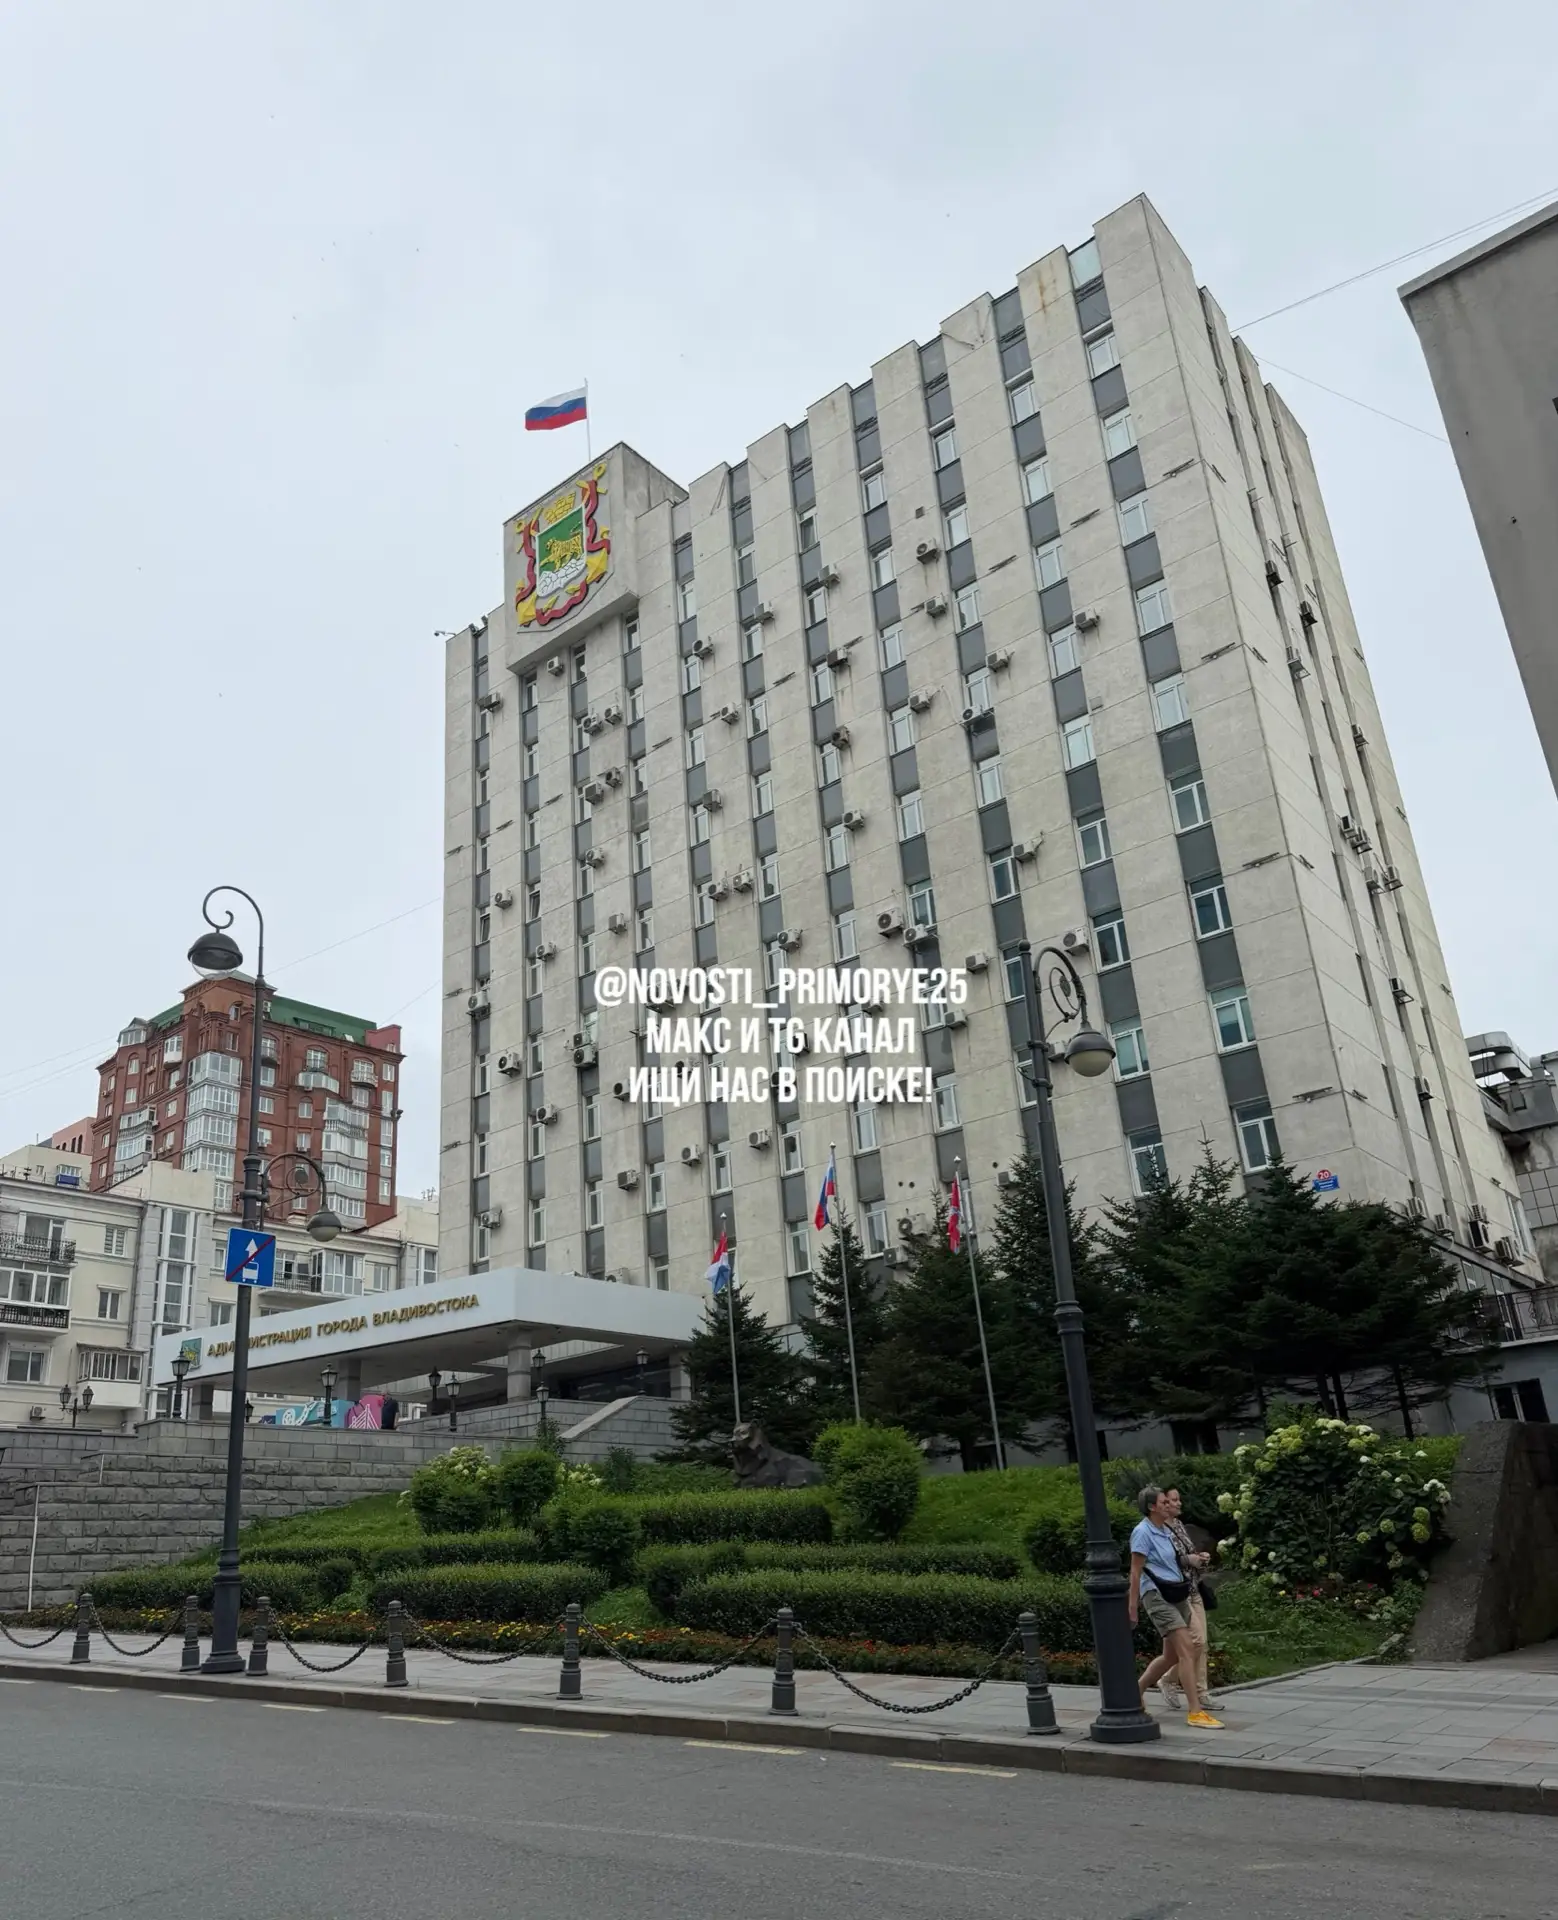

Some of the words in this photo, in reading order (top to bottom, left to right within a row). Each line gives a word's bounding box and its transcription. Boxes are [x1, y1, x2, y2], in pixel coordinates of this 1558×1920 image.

[207, 1326, 312, 1357] АДМИСТРАЦИЯ
[316, 1315, 368, 1337] ГОРОДА
[372, 1294, 480, 1326] ВЛАДИВОСТОКА
